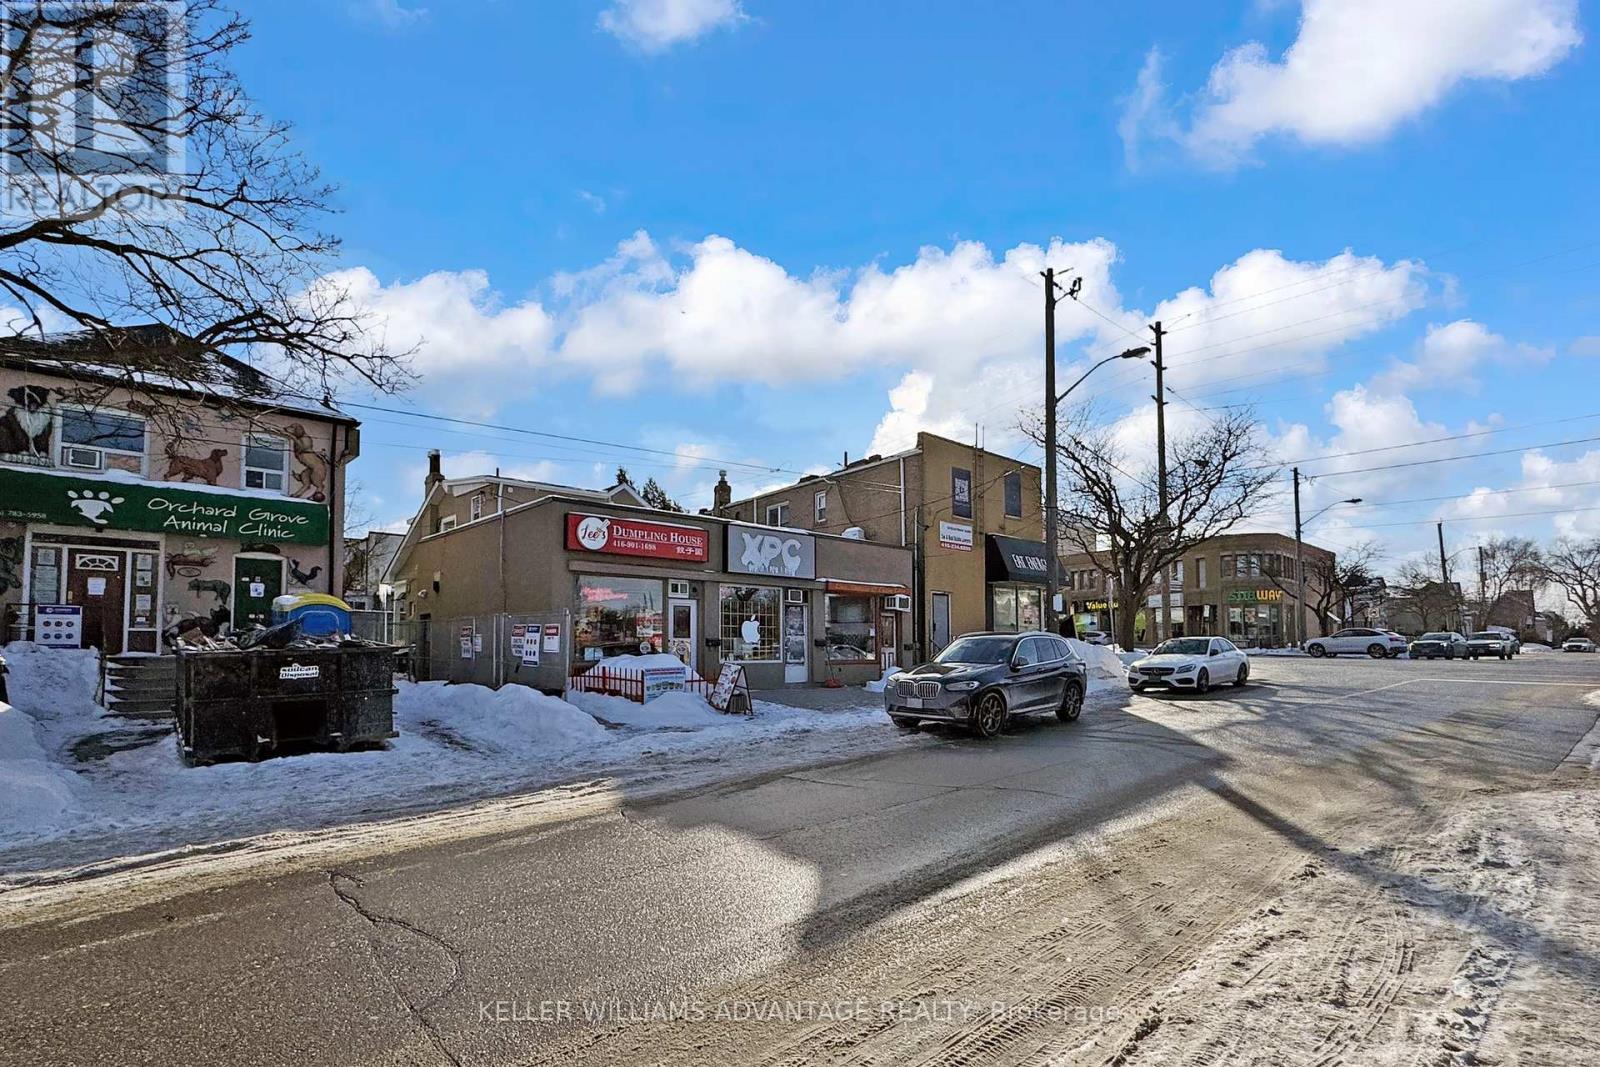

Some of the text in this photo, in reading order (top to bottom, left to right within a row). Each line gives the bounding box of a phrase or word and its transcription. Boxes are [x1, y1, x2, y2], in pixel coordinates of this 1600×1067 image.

[147, 498, 309, 524] Orchard Grove
[163, 515, 295, 538] Animal Clinic
[670, 532, 703, 545] HOUSE
[741, 532, 801, 575] XPC
